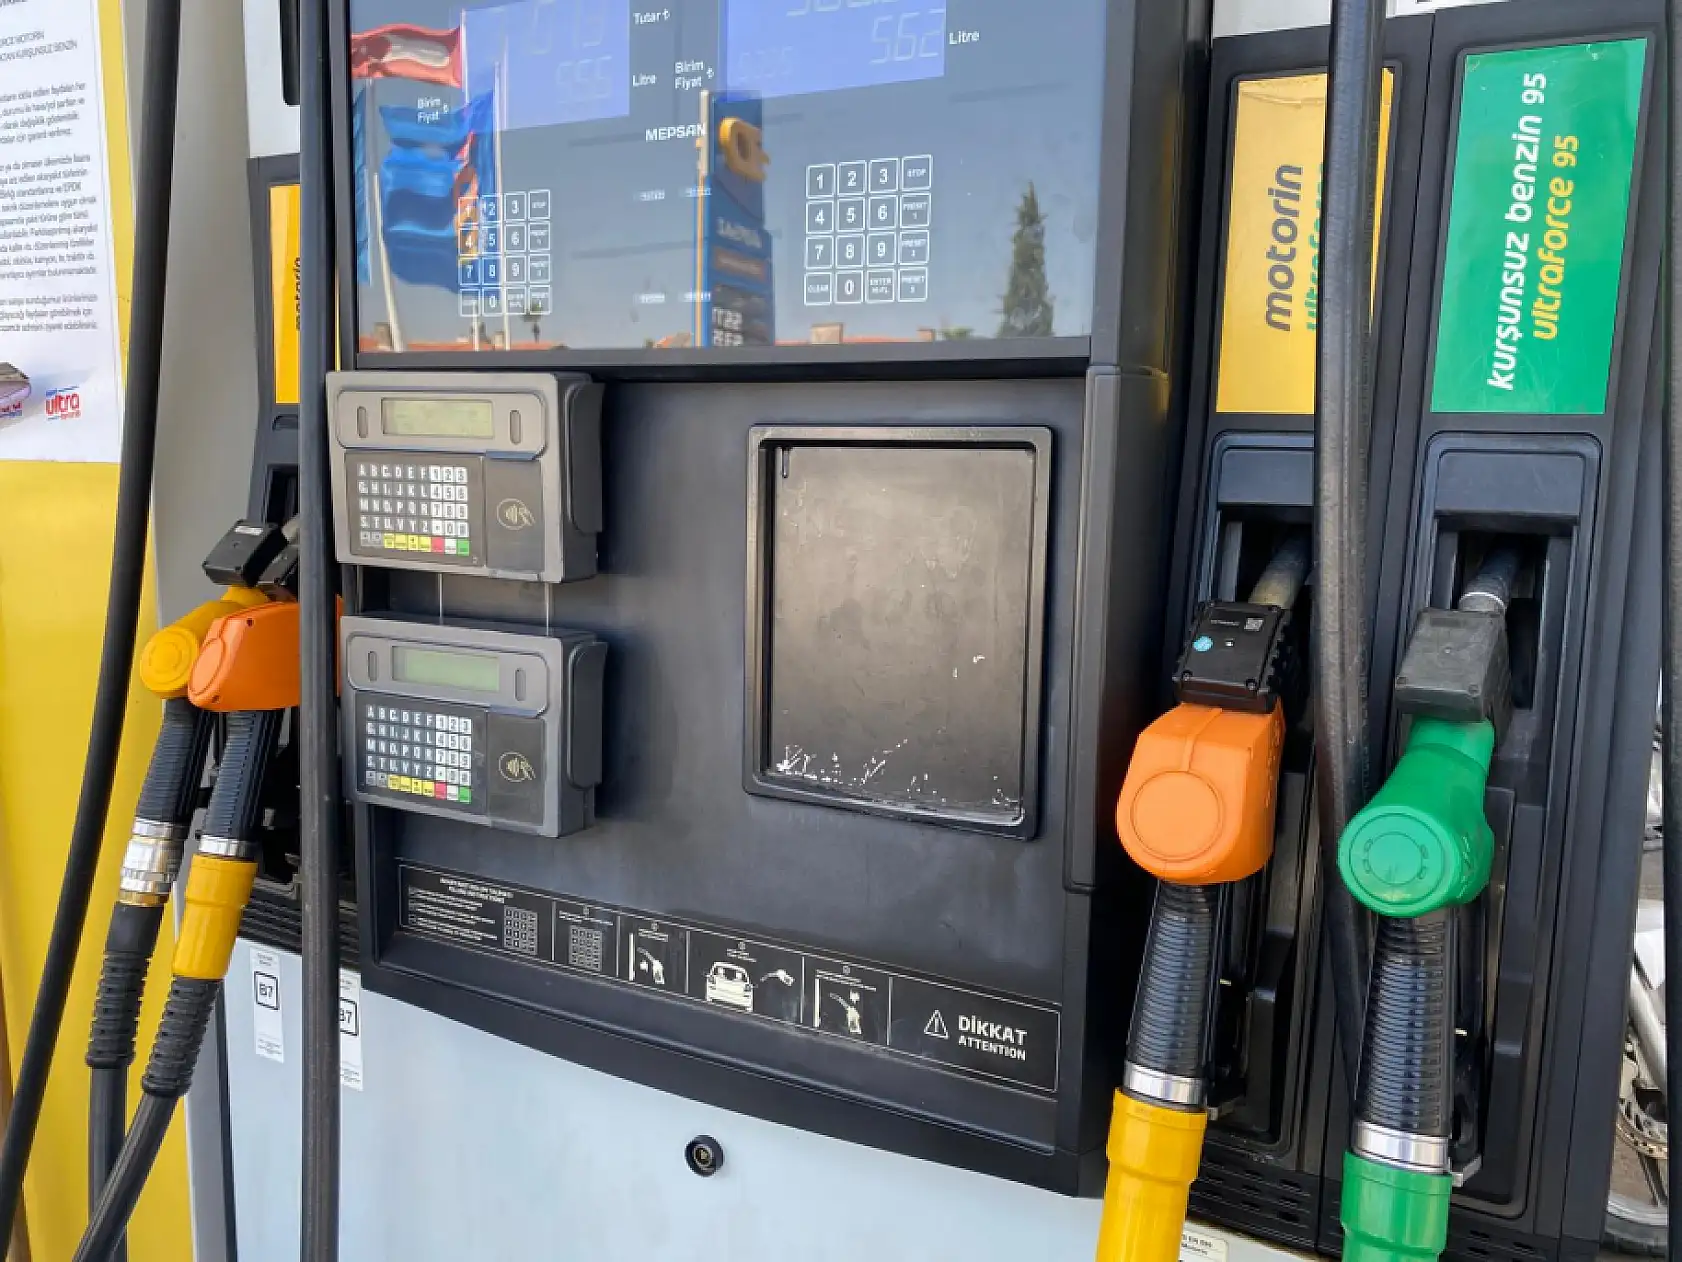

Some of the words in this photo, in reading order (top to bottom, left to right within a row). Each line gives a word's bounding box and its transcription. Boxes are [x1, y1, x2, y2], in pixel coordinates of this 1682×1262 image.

[949, 30, 979, 44] Litre
[1522, 72, 1546, 105] 95
[646, 124, 706, 142] MEPSAN
[816, 173, 823, 190] 1
[847, 170, 857, 187] 2
[879, 168, 888, 185] 3
[1505, 116, 1543, 222] benzin
[488, 203, 496, 216] 2
[511, 200, 519, 214] 3
[815, 209, 825, 226] 4
[846, 207, 856, 223] 5
[878, 204, 888, 222] 6
[465, 235, 473, 248] 4
[488, 233, 495, 247] 5
[511, 232, 519, 246] 6
[1265, 164, 1304, 332] motorin
[1531, 177, 1574, 341] ultraforce
[1553, 135, 1579, 168] 95
[815, 244, 824, 261] 7
[845, 243, 855, 260] 8
[877, 241, 886, 258] 9
[488, 265, 496, 278] 8
[511, 262, 519, 277] 9
[844, 280, 854, 295] 0
[488, 295, 497, 309] 0
[1487, 232, 1530, 391] kurşunsuz
[46, 393, 79, 414] ultra
[958, 1014, 1028, 1046] DİKKAT
[958, 1035, 1026, 1061] ATTENTION
